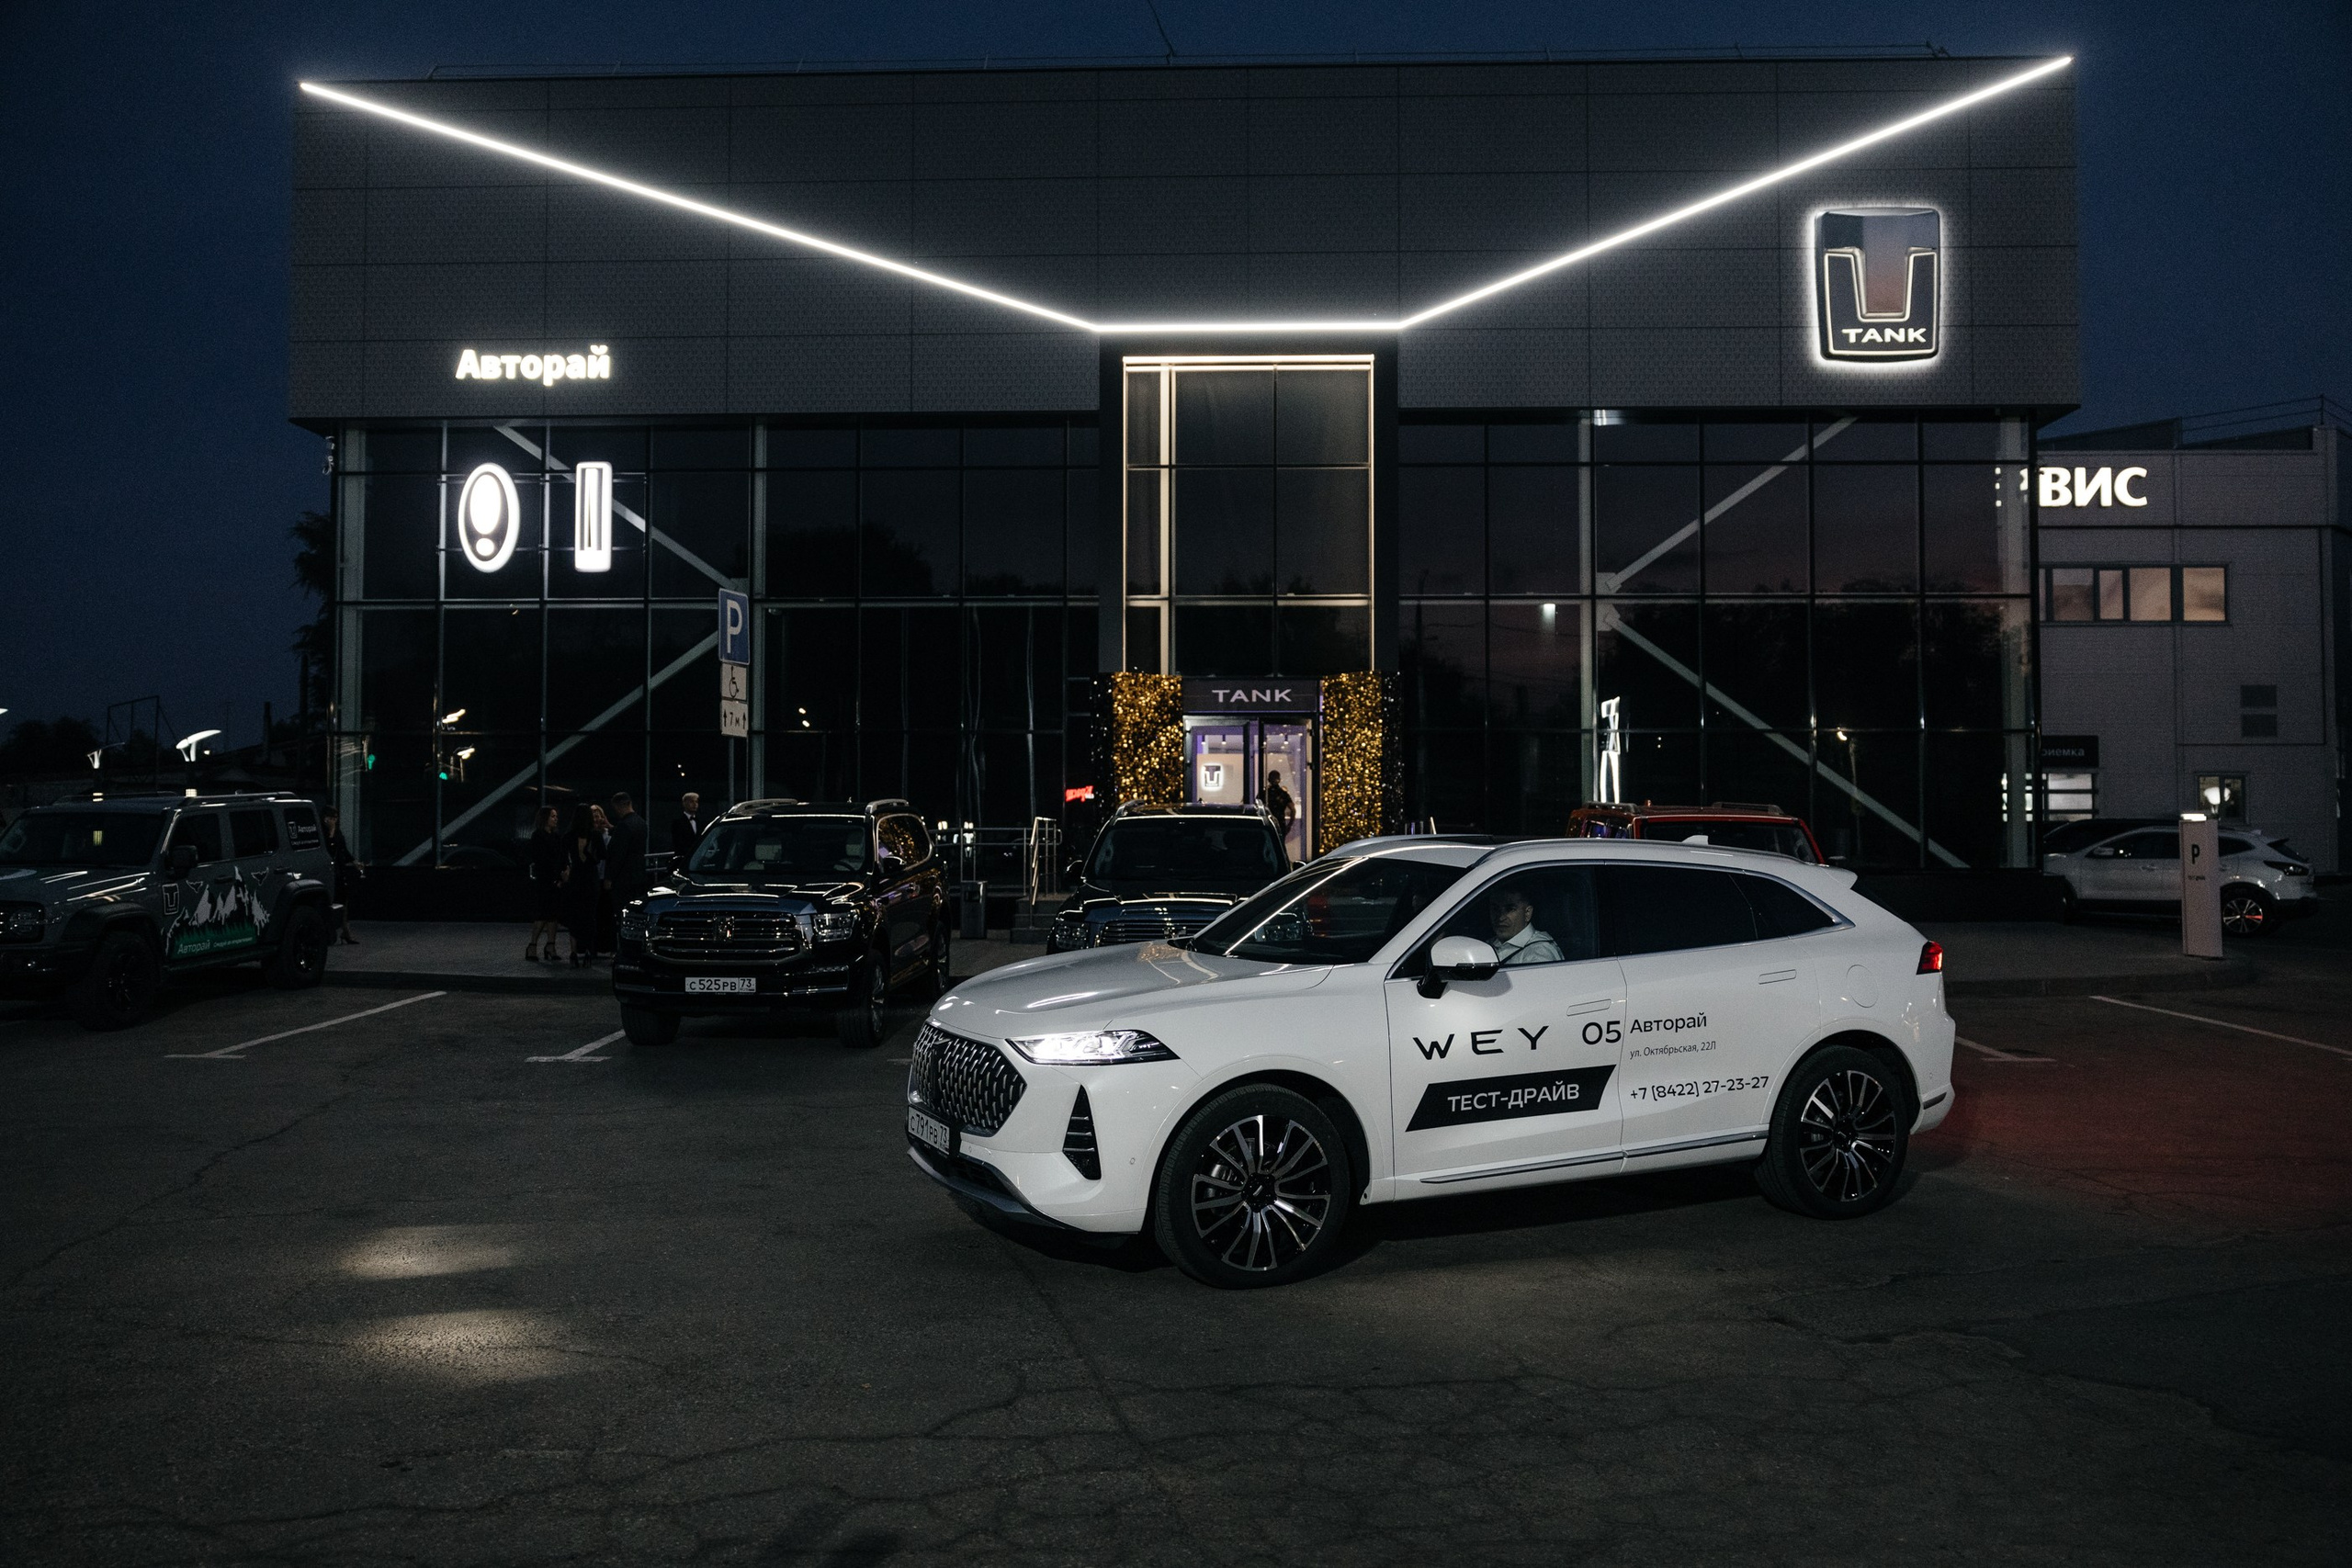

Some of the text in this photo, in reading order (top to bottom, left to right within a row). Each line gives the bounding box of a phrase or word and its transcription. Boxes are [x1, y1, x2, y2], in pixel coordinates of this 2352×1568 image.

[1841, 327, 1928, 344] TANK
[455, 344, 611, 387] Авторай
[727, 599, 742, 653] P
[1211, 689, 1292, 703] TANK
[2192, 844, 2200, 863] P
[177, 939, 211, 954] Авторай
[1630, 1012, 1707, 1033] Авторай
[1412, 1025, 1549, 1060] WEY
[1629, 1041, 1716, 1059] ул. Октябрьская, 22Л
[1447, 1080, 1580, 1112] ТЕСТ-ДРАЙВ
[1630, 1076, 1770, 1101] +7 (8422) 27-23-27
